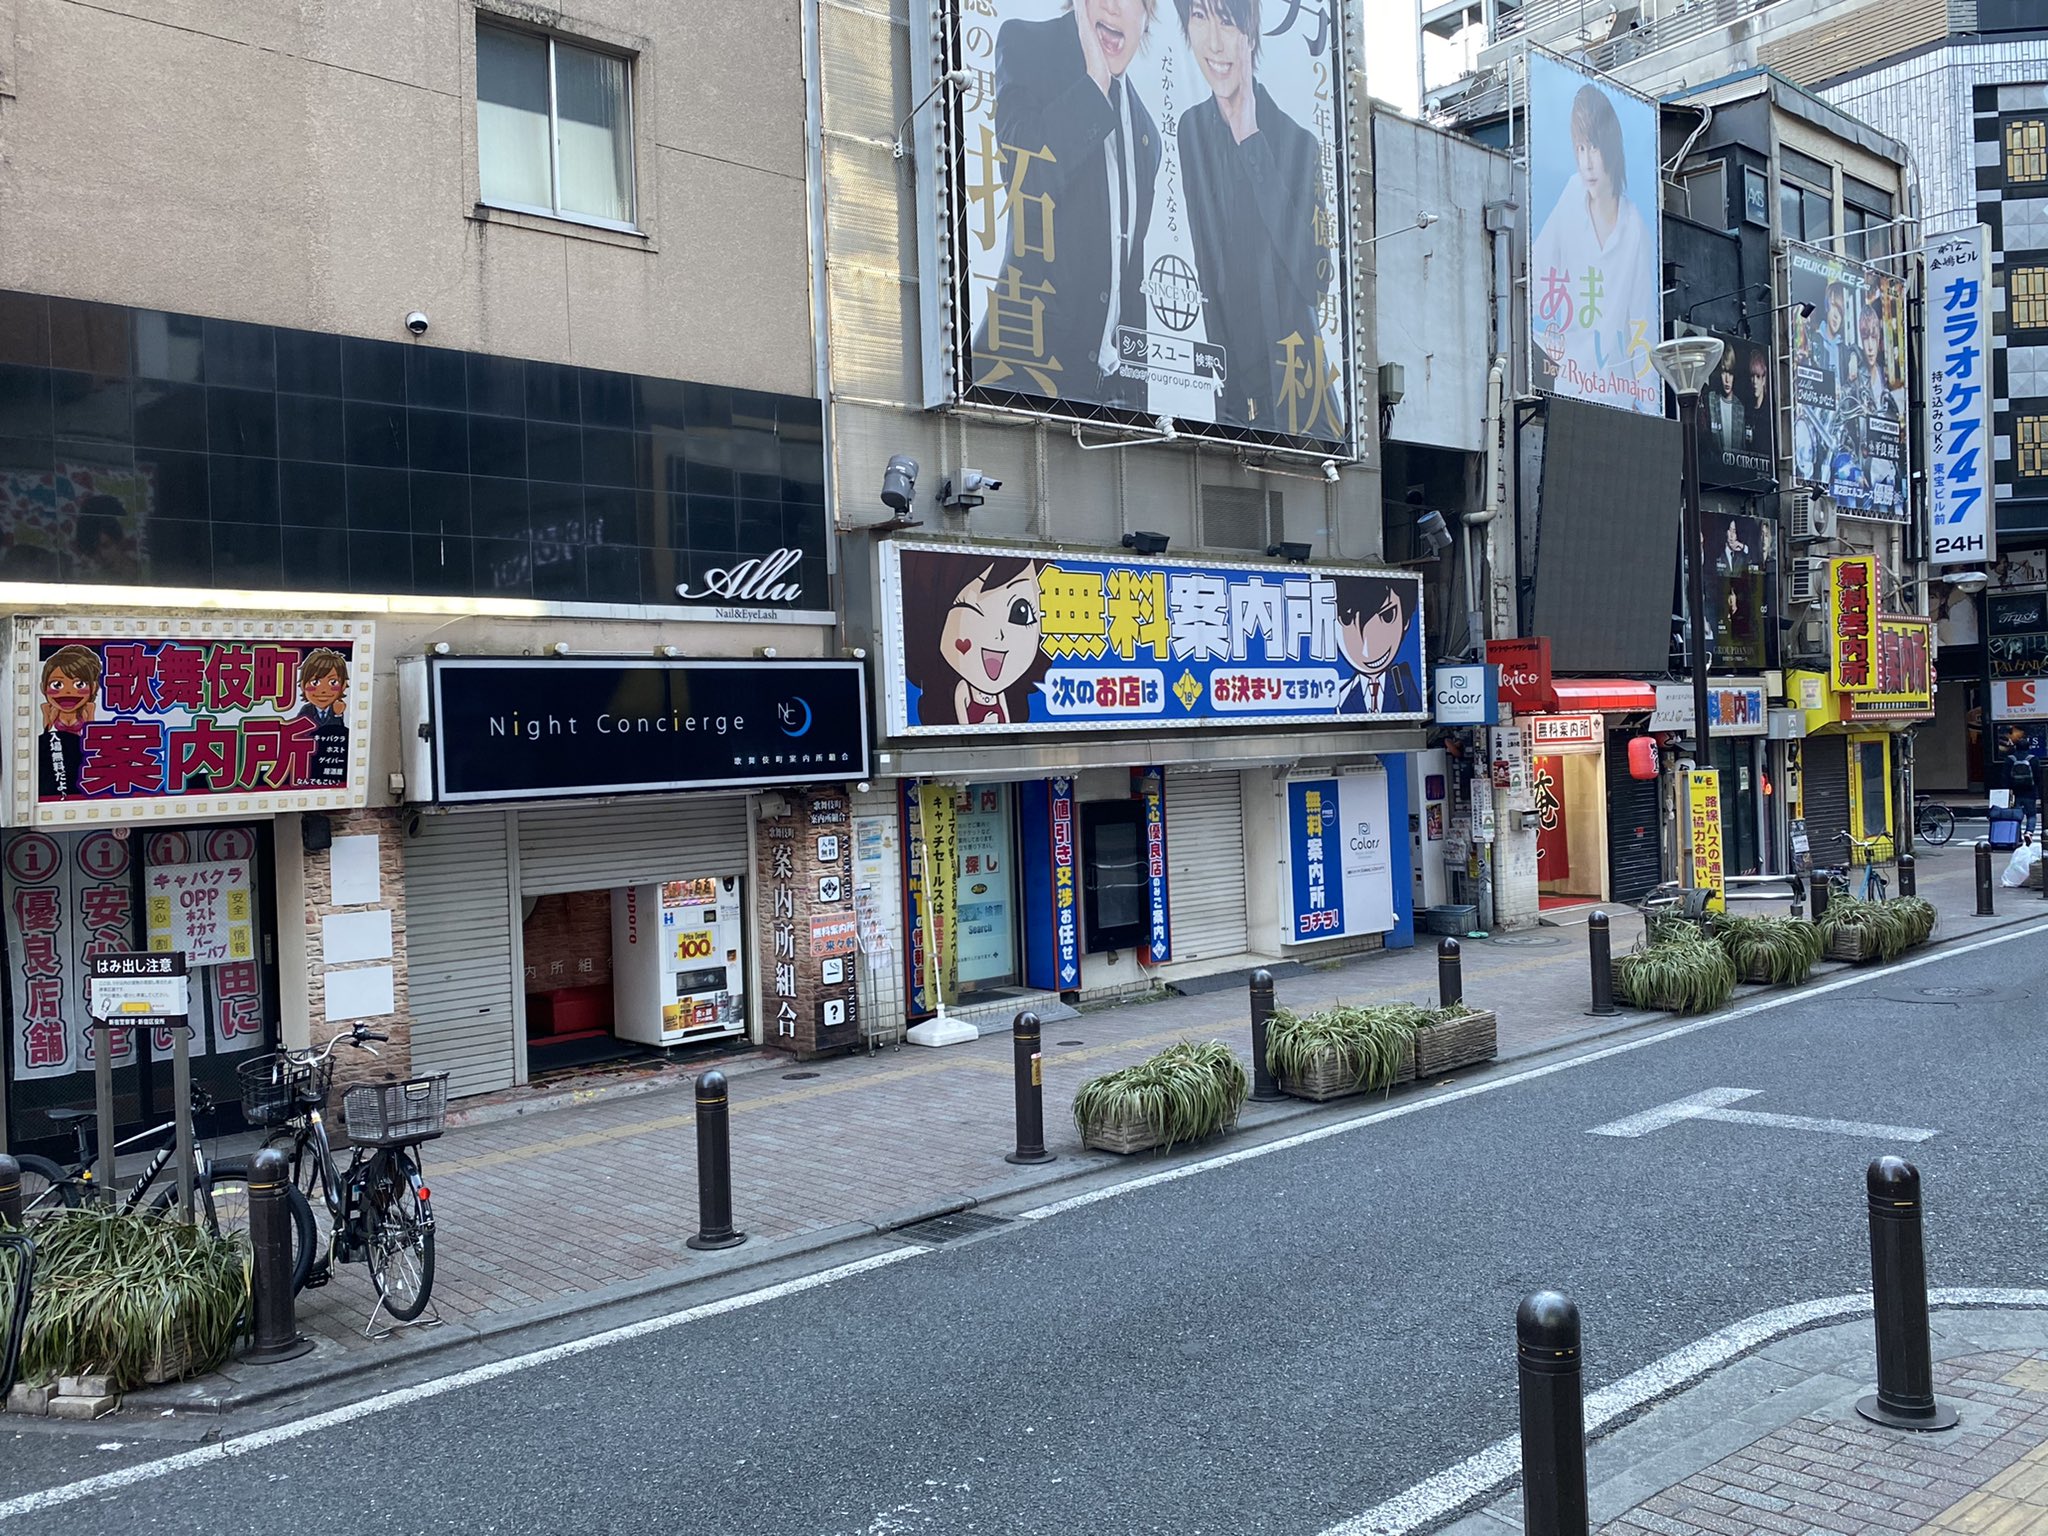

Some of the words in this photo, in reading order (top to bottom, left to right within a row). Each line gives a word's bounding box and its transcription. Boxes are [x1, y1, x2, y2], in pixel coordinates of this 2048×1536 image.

[963, 0, 999, 121] の男
[966, 124, 1064, 399] 拓真
[1148, 282, 1180, 301] SINCE
[1181, 287, 1203, 305] YOU
[1122, 334, 1190, 361] シンスユー
[1195, 351, 1214, 369] 検索
[1119, 363, 1212, 392] sinceyougroup.com
[1275, 330, 1344, 436] 秋
[1567, 358, 1606, 395] Ryota
[1606, 371, 1656, 402] Amairo
[1943, 277, 1982, 523] カラオケ747
[1933, 462, 1946, 525] 東宝ビル前
[1935, 535, 1984, 554] 24H
[676, 547, 802, 600] Allu
[715, 608, 778, 621] Nail&EyeLash
[1038, 566, 1337, 661] 無料案内所
[1837, 561, 1870, 687] 無料案内所
[103, 641, 302, 712] 歌舞伎町
[1052, 675, 1159, 708] 次のお店は
[1214, 675, 1336, 706] お決まりですか?
[1437, 690, 1481, 704] Colors
[490, 712, 577, 740] Night
[597, 709, 745, 736] Concierge
[1538, 719, 1590, 738] 無料案内所
[80, 714, 318, 795] 案内所
[821, 838, 835, 847] 入場
[821, 848, 835, 857] 無料
[1305, 790, 1325, 909] 無料案内所
[1350, 838, 1379, 851] Colors
[842, 834, 852, 900] KABUKICHO
[965, 854, 998, 874] 探し
[153, 868, 243, 889] キャバクラ
[1053, 799, 1074, 960] 値引き交渉お任せ
[154, 900, 167, 923] 安心
[180, 888, 219, 908] OPP
[231, 893, 244, 915] 安全
[186, 908, 216, 922] ホスト
[1300, 908, 1340, 933] コチラ!
[187, 923, 216, 936] オカマ
[233, 929, 245, 953] 情報
[772, 844, 797, 1038] 案内所組合
[813, 921, 855, 939] 無料案内所
[968, 924, 992, 935] Search
[193, 938, 213, 949] バー
[678, 939, 711, 959] 100
[14, 889, 66, 1066] 優良店舗
[97, 958, 172, 973] はみ出し注意
[848, 986, 856, 1021] UNION
